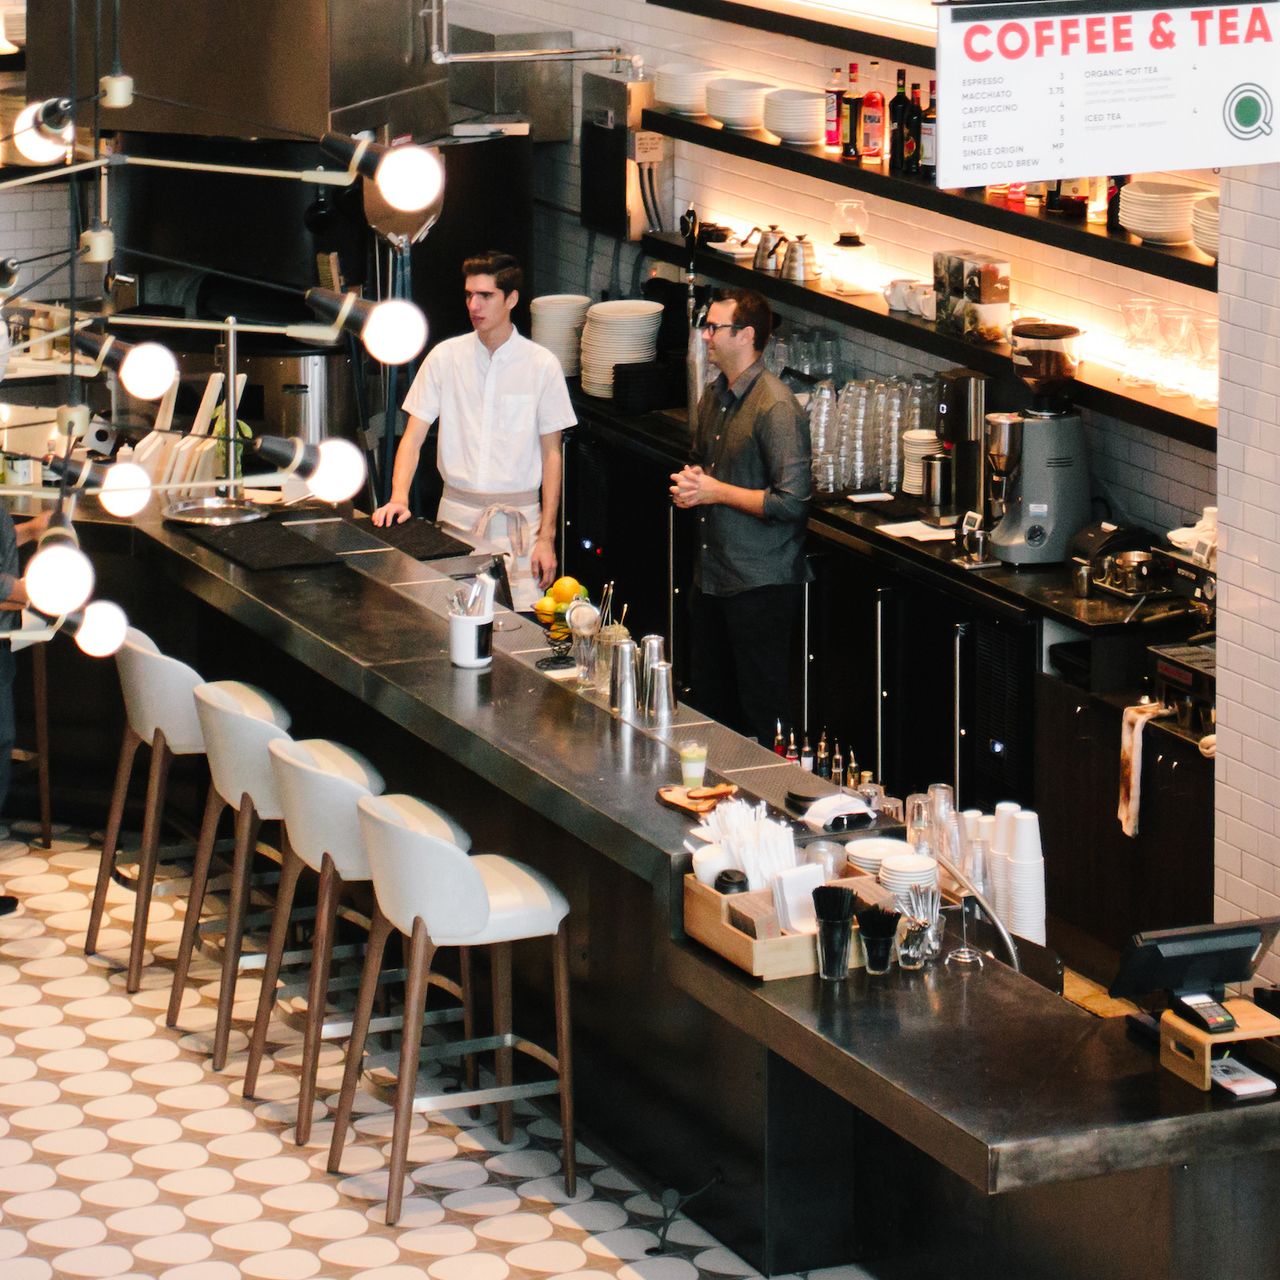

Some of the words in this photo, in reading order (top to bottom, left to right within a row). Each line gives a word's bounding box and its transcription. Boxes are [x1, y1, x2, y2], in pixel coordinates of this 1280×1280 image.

[962, 15, 1134, 63] COFFEE
[1149, 12, 1176, 50] &
[1190, 6, 1274, 47] TEA
[1084, 68, 1123, 79] ORGANIC
[1125, 67, 1142, 76] HOT
[1144, 66, 1158, 74] TEA
[962, 76, 1004, 87] ESPRESSO
[962, 90, 1012, 100] MACCHIATO
[962, 104, 1018, 115] CAPPUCCINO
[1085, 114, 1104, 122] ICED
[1107, 112, 1121, 121] TEA
[962, 120, 987, 129] LATTE
[962, 134, 988, 143] FILTER
[963, 148, 992, 158] SINGLE
[994, 145, 1024, 155] ORIGIN
[1052, 142, 1064, 150] MP
[963, 162, 988, 171] NITRO
[990, 160, 1014, 170] COLD
[1016, 158, 1040, 168] BREW
